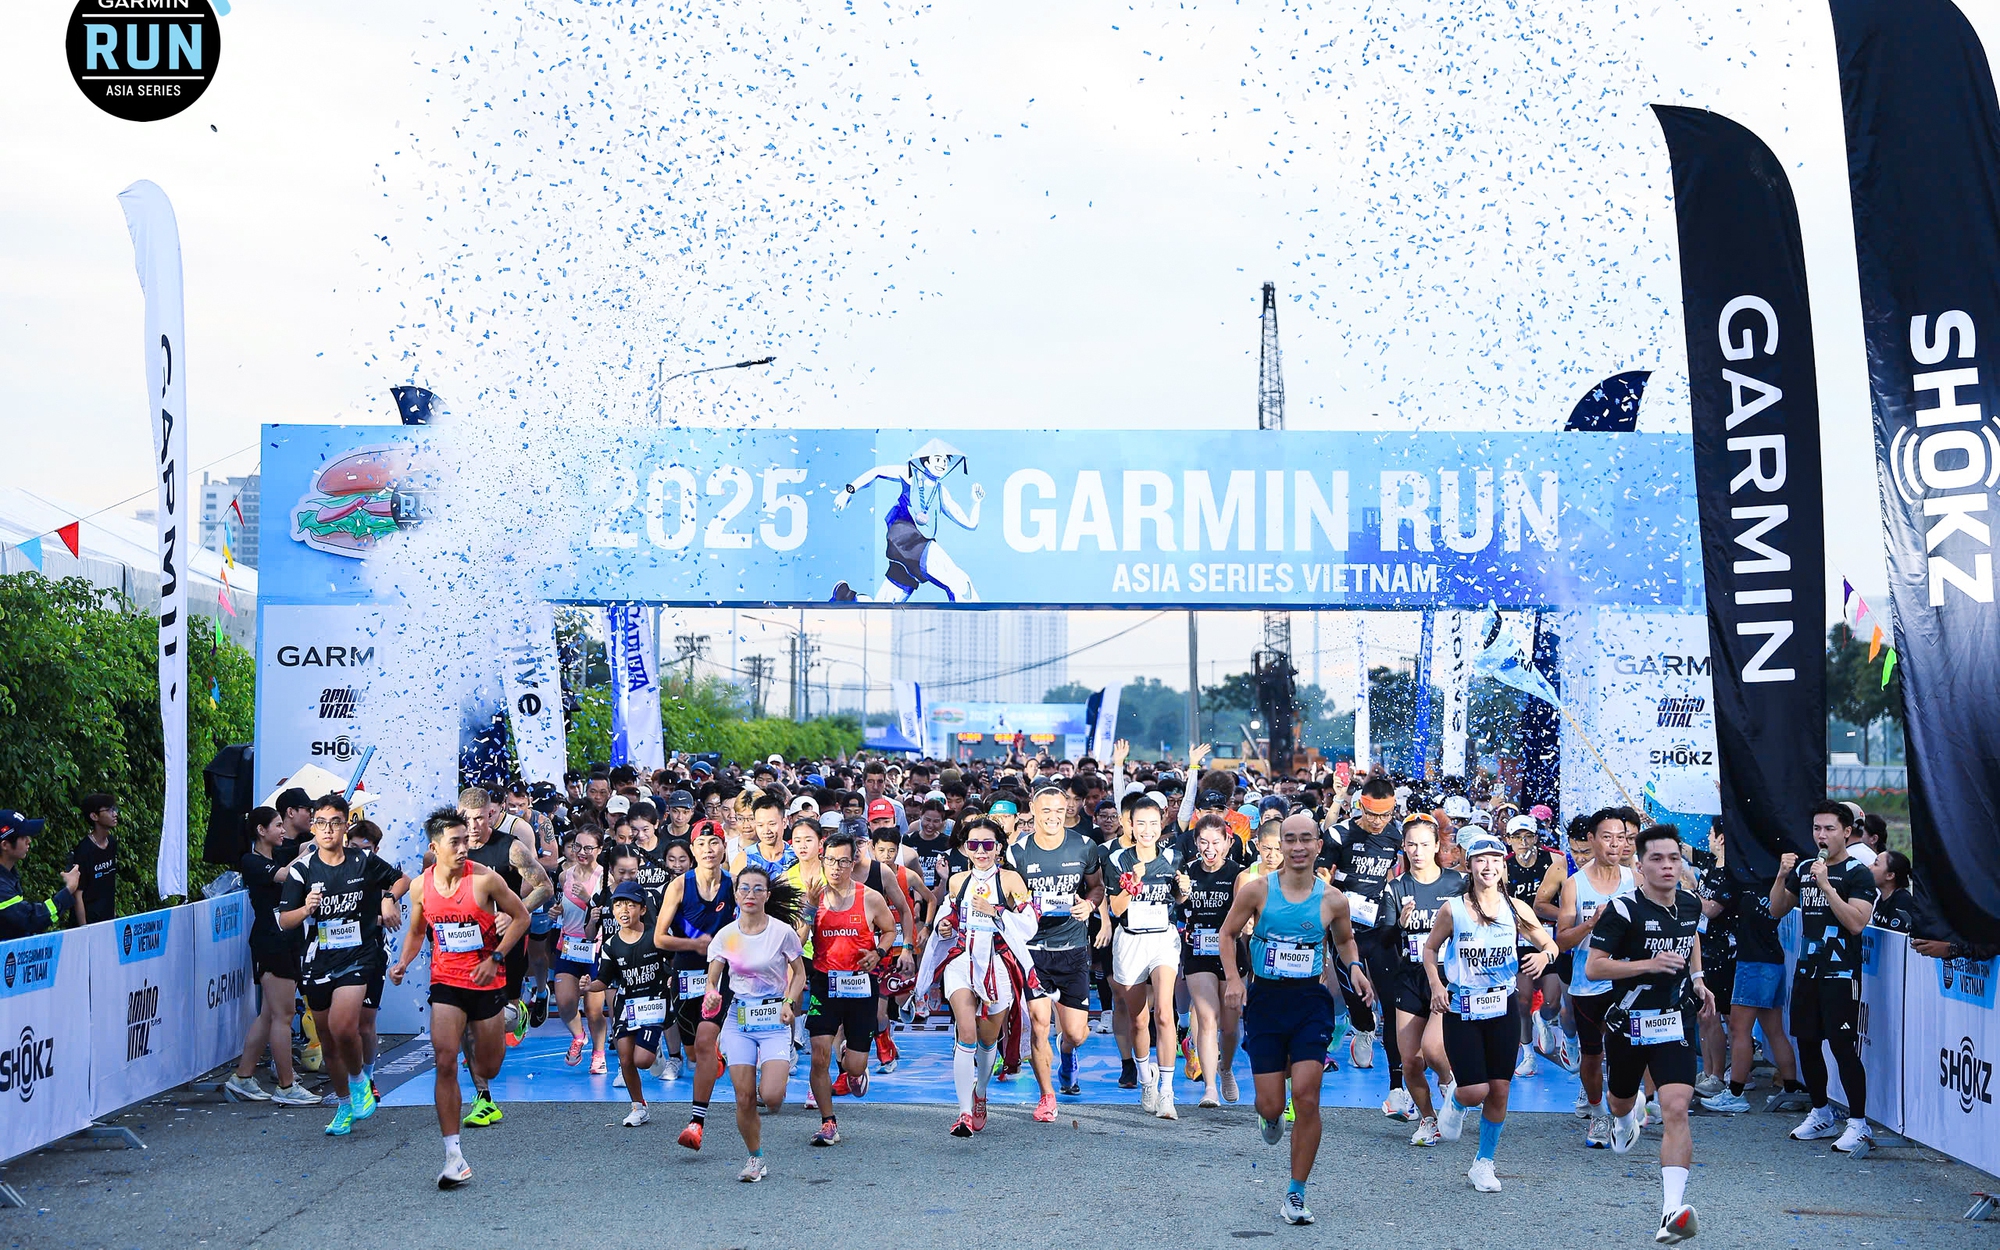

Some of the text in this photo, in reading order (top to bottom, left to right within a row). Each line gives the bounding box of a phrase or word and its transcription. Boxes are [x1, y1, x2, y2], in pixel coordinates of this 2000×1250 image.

[1909, 308, 1995, 608] SHOKZ
[1718, 295, 1796, 683] GARMIN
[590, 463, 1559, 552] 2025 GARMIN RUN
[1112, 563, 1439, 593] ASIA SERIES VIETNAM
[277, 646, 375, 667] GARM
[1614, 655, 1711, 676] GARM
[1657, 713, 1692, 727] VITAL
[311, 741, 362, 755] SHOK
[1650, 750, 1712, 765] SHOKZ
[1351, 855, 1375, 867] FROM
[636, 869, 652, 879] ROM
[1355, 865, 1388, 877] TO HERO
[646, 875, 666, 884] HERO
[1027, 873, 1080, 889] FROM ZERO
[1049, 880, 1074, 893] HERO
[1802, 887, 1818, 897] ROM
[320, 890, 364, 907] ROM ZERO
[1144, 892, 1166, 901] HERO
[1189, 891, 1230, 901] ROM ZERO
[320, 901, 357, 916] TO HERO
[1191, 899, 1223, 909] TO HERO
[602, 918, 619, 928] ROM
[1408, 919, 1435, 930] TO HE
[331, 926, 356, 936] M50467
[604, 926, 614, 935] TO
[822, 928, 858, 938] UDAQUA
[1644, 937, 1673, 950] FROM
[1280, 952, 1310, 962] M50075
[1459, 945, 1513, 959] FROM ZERO
[1467, 956, 1506, 968] TO HERO
[622, 962, 660, 979] ROM ZERO
[635, 972, 656, 986] HERO
[207, 967, 246, 1010] GARMIN
[127, 978, 159, 1026] amino
[1476, 995, 1501, 1005] F50175
[750, 1007, 777, 1017] F50798
[1645, 1016, 1676, 1028] M50072
[127, 1020, 149, 1062] VITAL
[0, 1037, 54, 1093] SHOKZ
[1939, 1046, 1993, 1105] SHOKZ
